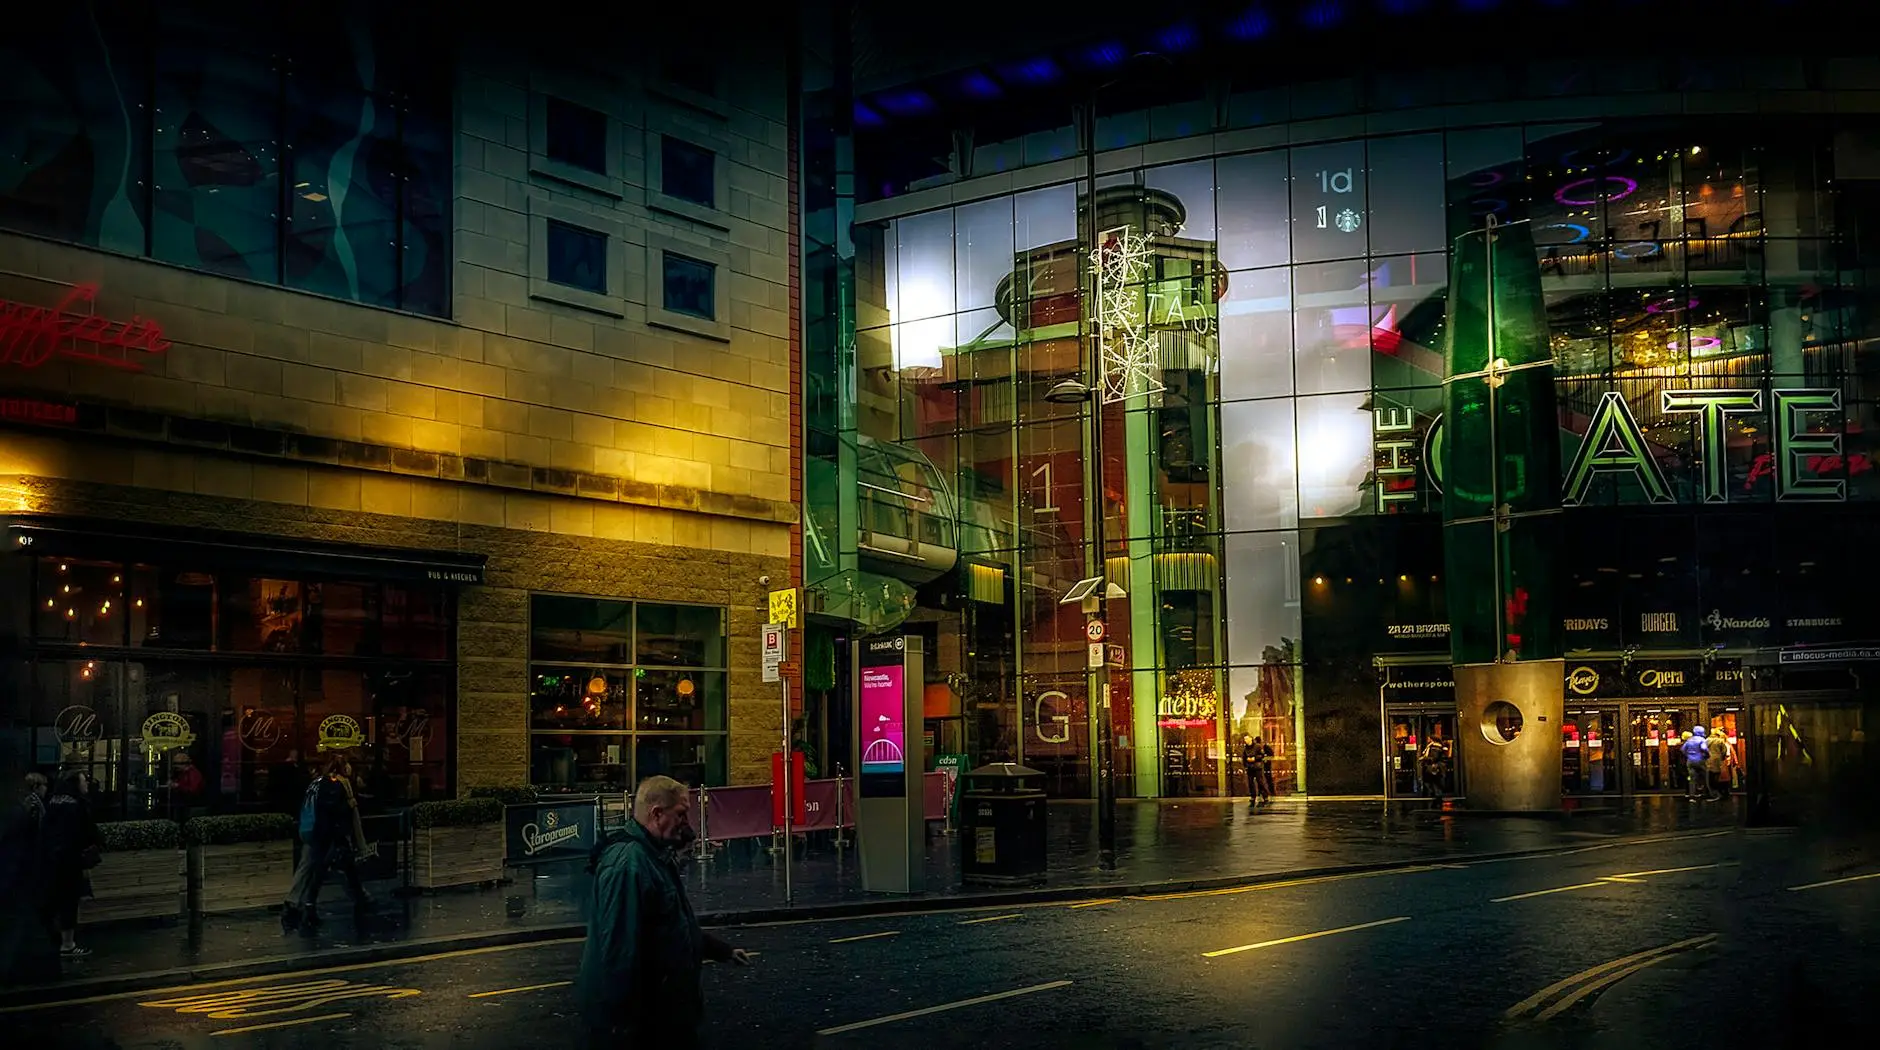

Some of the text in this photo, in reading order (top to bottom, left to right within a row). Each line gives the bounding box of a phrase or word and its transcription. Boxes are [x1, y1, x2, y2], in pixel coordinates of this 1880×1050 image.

[1374, 405, 1417, 514] THE
[1089, 625, 1102, 635] 20
[1415, 623, 1452, 634] BAZAAR
[1722, 617, 1771, 628] Nando's
[1786, 617, 1843, 628] STARBUCKS
[1640, 669, 1685, 688] Opera
[1035, 690, 1070, 744] G
[521, 822, 580, 856] Staropramen
